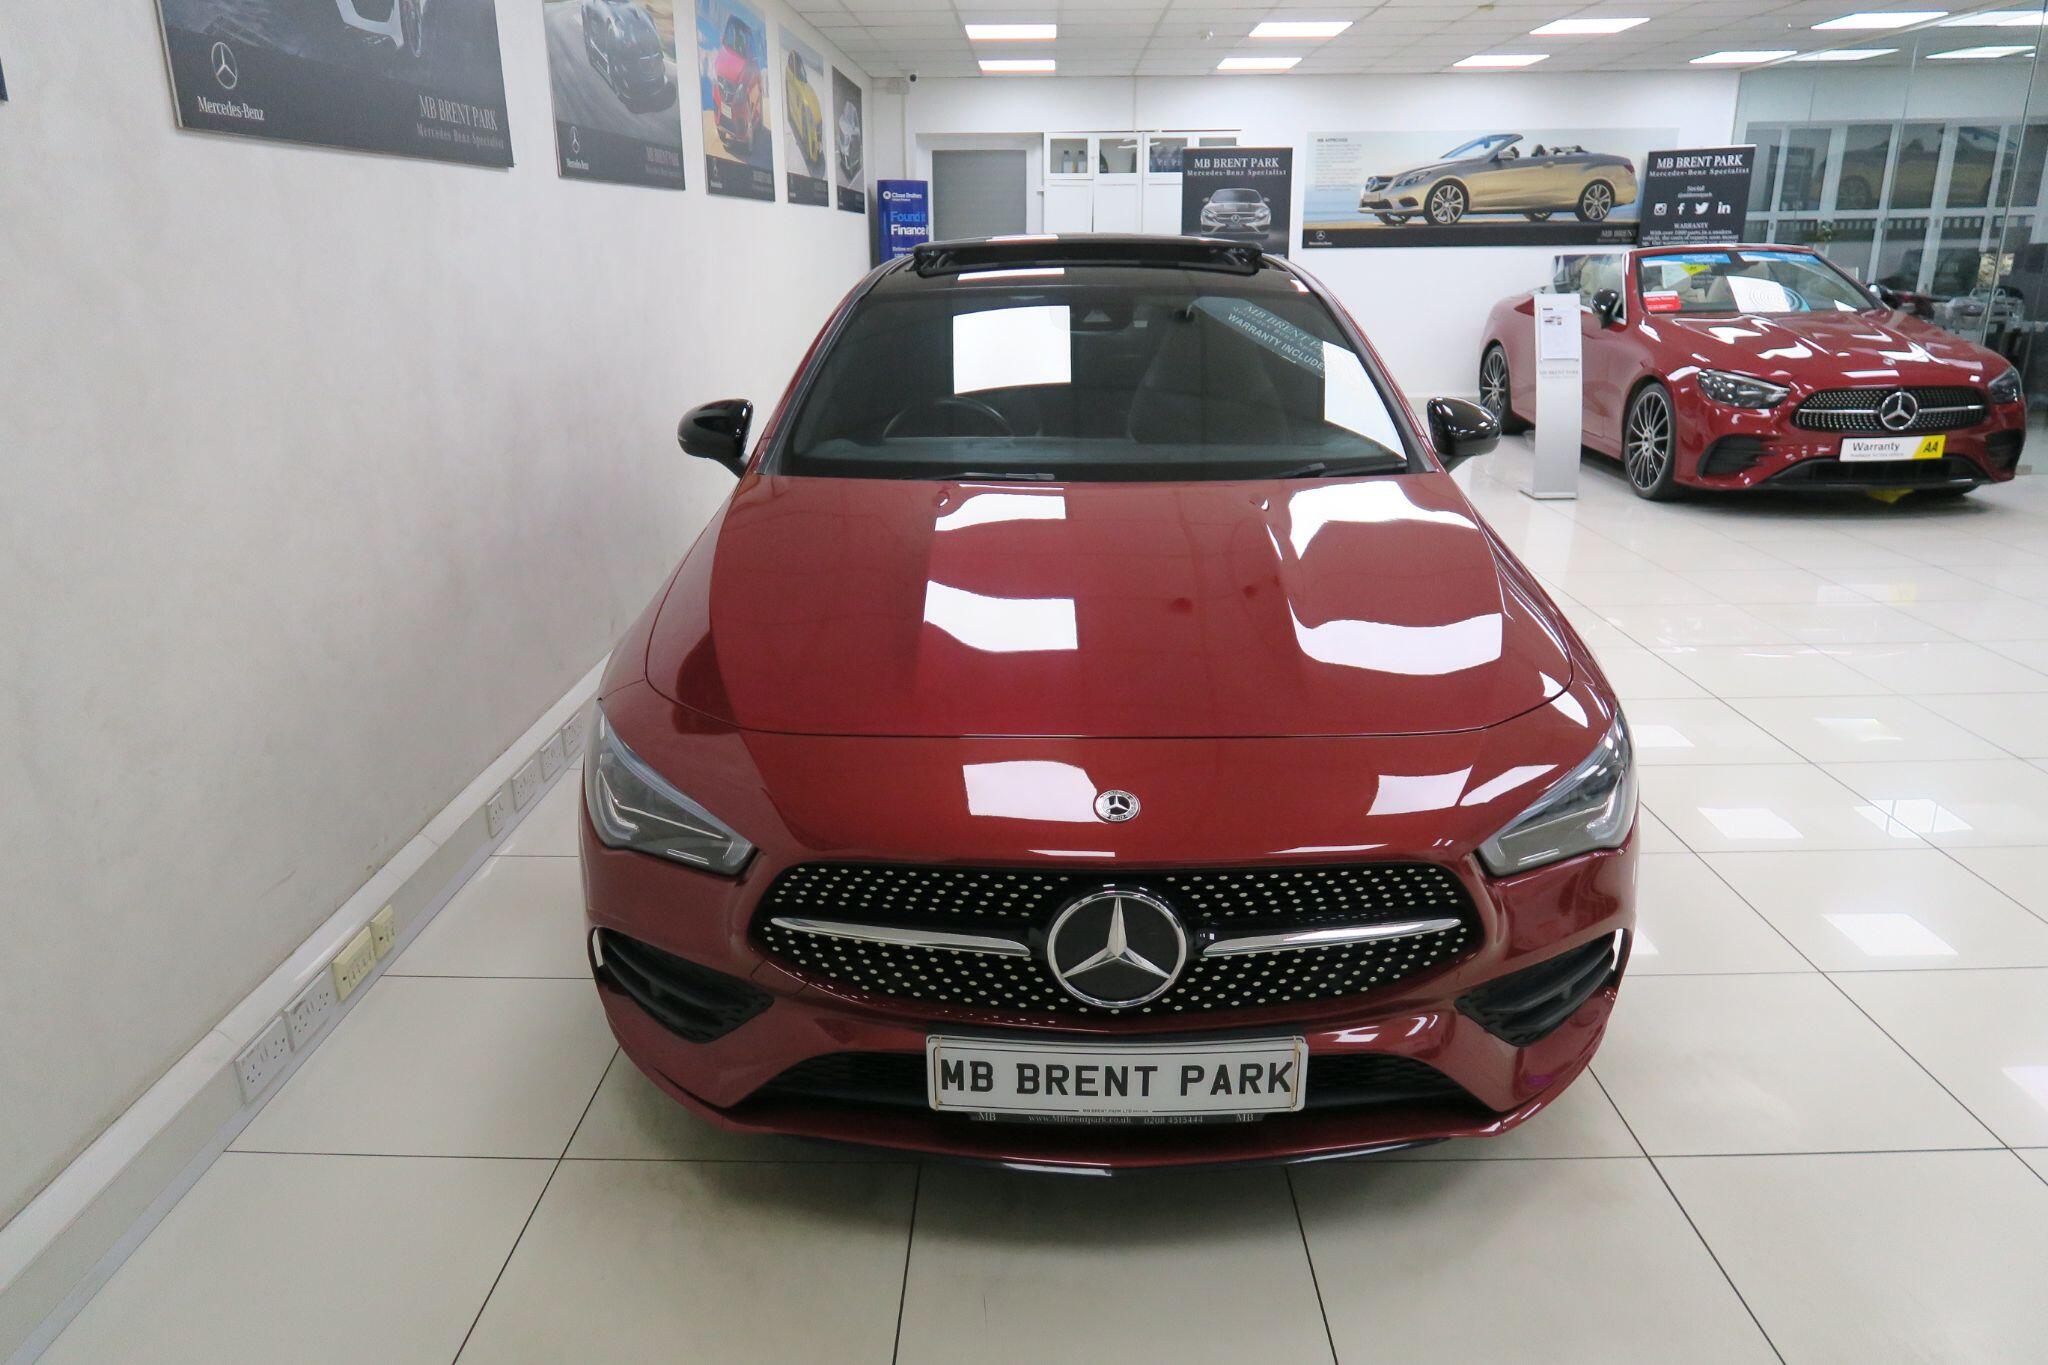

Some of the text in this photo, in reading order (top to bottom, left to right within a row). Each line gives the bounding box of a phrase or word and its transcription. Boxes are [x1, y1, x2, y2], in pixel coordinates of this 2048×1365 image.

[197, 95, 265, 121] Mercedes-Benz
[418, 94, 498, 131] MB BRENT PARK
[1194, 157, 1279, 168] MB BRENT PARK
[1656, 154, 1743, 169] MB BRENT PARK
[1247, 168, 1287, 177] Specialist
[1709, 167, 1749, 176] Specialist
[890, 211, 921, 222] Found
[890, 224, 925, 235] Finance
[1613, 229, 1635, 238] BREN
[1266, 315, 1311, 341] BRENT
[1228, 313, 1281, 347] WARRANTY
[1280, 342, 1325, 372] INCLUDE
[1853, 440, 1939, 453] Warranty AA
[940, 1058, 1294, 1097] MB BRENT PARK
[977, 1112, 997, 1121] MB
[1235, 1112, 1254, 1122] MB
